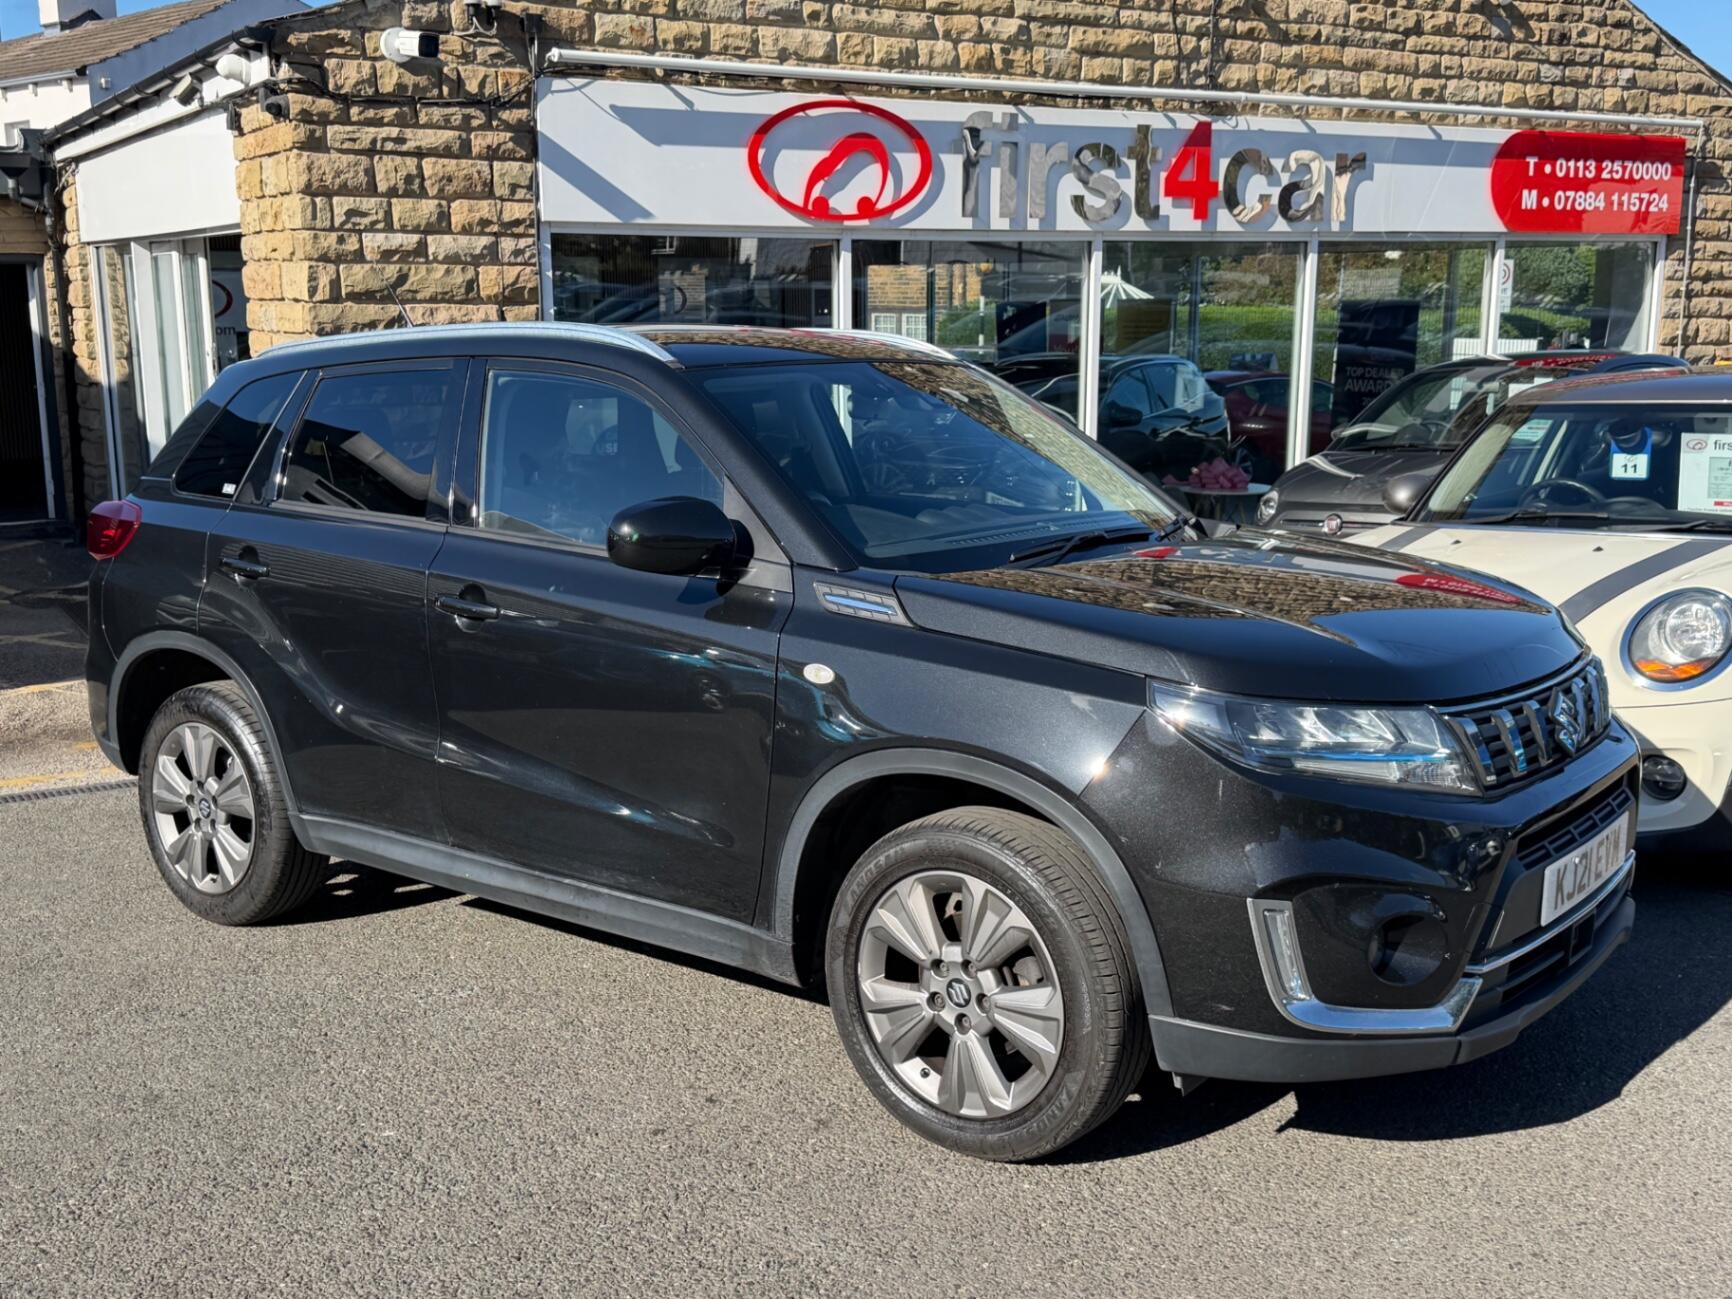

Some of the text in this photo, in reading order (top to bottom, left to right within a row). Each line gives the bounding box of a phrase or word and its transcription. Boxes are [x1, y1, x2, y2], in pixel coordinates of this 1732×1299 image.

[962, 111, 1367, 223] first4car
[1525, 156, 1672, 181] T 0113 2570000
[1521, 189, 1668, 212] M 07884 115724
[1345, 366, 1364, 377] TOP
[1621, 464, 1637, 473] 11
